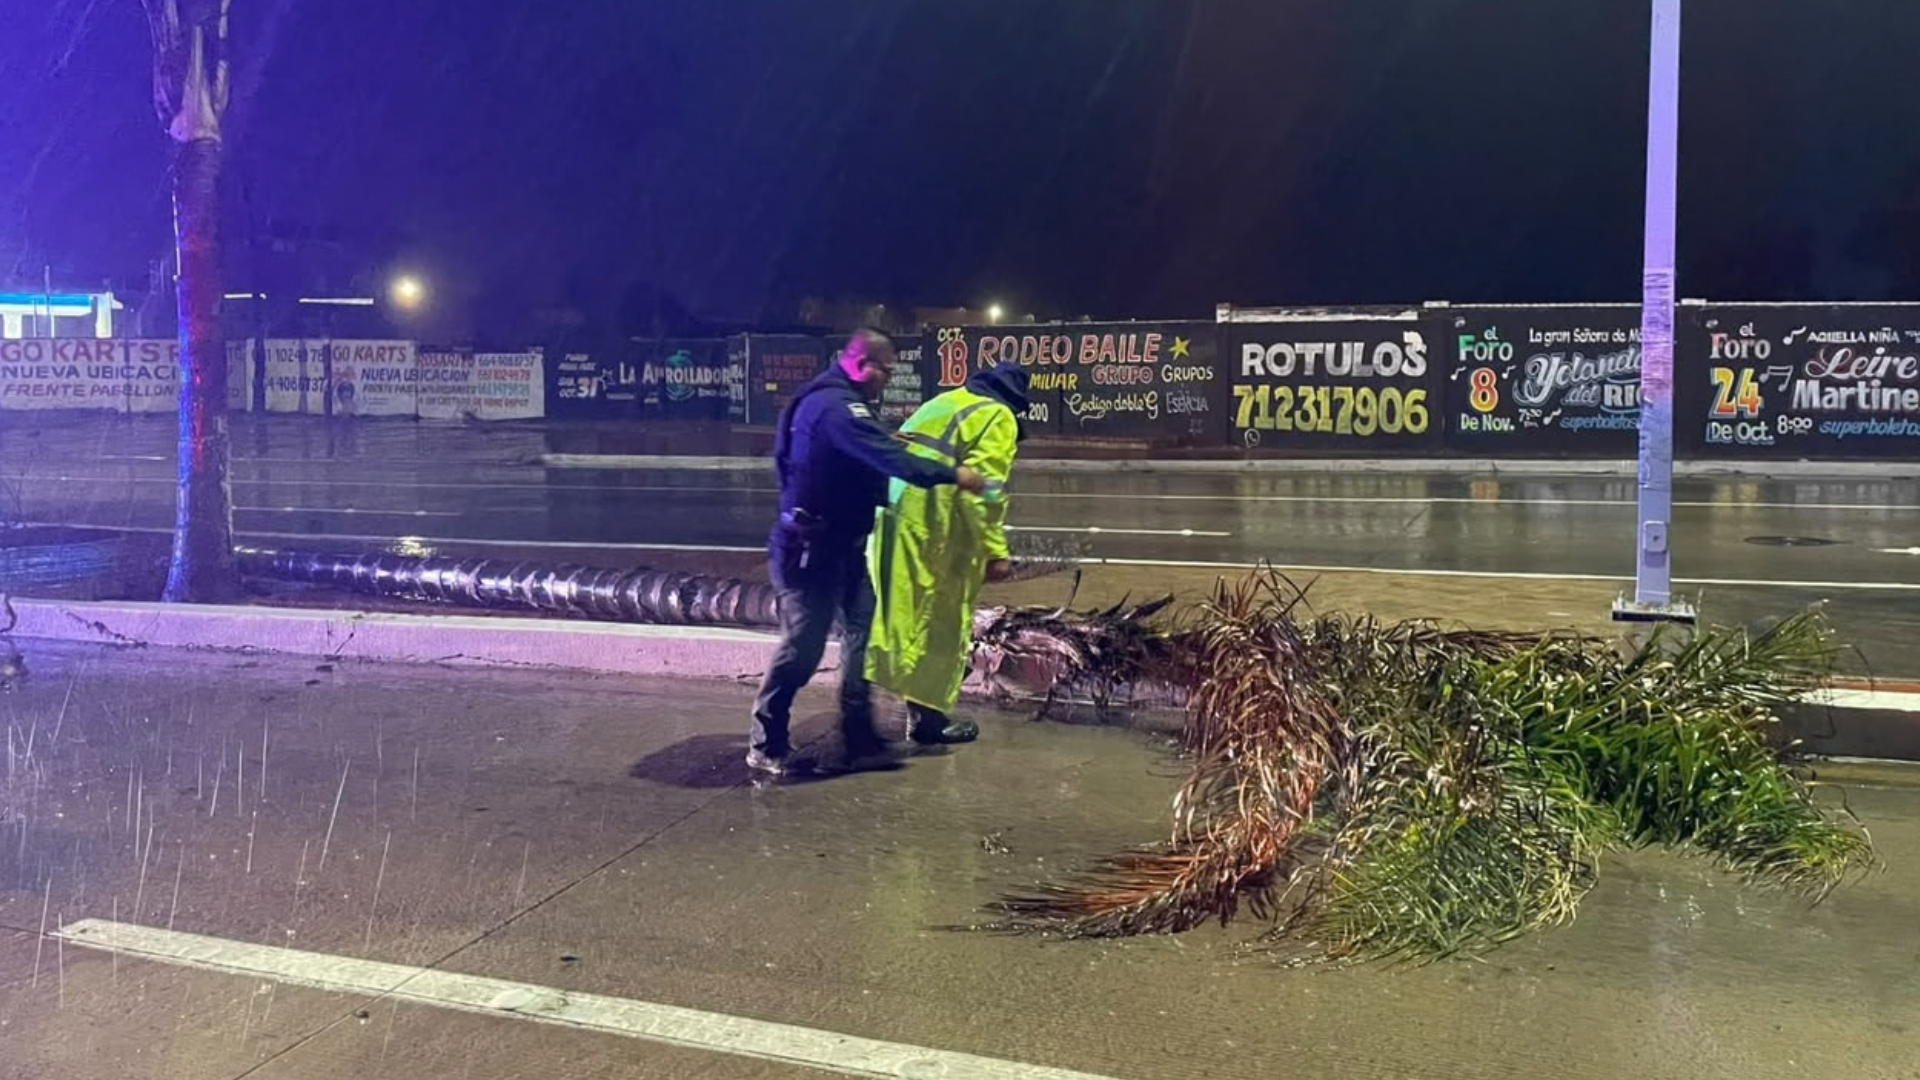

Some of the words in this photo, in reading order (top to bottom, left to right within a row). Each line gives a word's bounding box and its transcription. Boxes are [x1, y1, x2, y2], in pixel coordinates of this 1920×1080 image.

[937, 328, 964, 342] OCT.
[1529, 327, 1542, 343] La
[1544, 331, 1570, 347] gran
[1740, 323, 1755, 337] el
[1807, 330, 1866, 343] AQUELLA
[1869, 326, 1900, 343] NIÑA
[0, 342, 43, 363] GO
[52, 341, 159, 363] KARTS
[333, 345, 350, 362] GO
[354, 345, 407, 362] KARTS
[977, 335, 1072, 368] RODEO
[1079, 333, 1162, 364] BAILE
[1241, 331, 1427, 377] ROTULOS
[1458, 335, 1513, 361] Foro
[1709, 333, 1771, 359] Foro
[2, 365, 80, 380] NUEVA
[87, 364, 176, 381] UBICACI
[938, 340, 968, 386] 18
[1161, 364, 1214, 382] GRUPOS
[1805, 347, 1918, 380] Leire
[361, 367, 402, 382] NUEVA
[1029, 372, 1078, 390] MILIAR
[1092, 365, 1153, 385] GRUPO
[3, 383, 87, 397] FRENTE
[1469, 367, 1499, 412] 8
[1710, 367, 1764, 418] 24
[1793, 379, 1920, 411] Martine
[1028, 402, 1048, 422] 200
[1233, 384, 1429, 436] 712317906
[1461, 413, 1478, 430] De
[1482, 413, 1515, 431] Nov.
[1777, 415, 1813, 435] 8:00
[1708, 422, 1733, 442] De
[1737, 422, 1774, 443] Oct.
